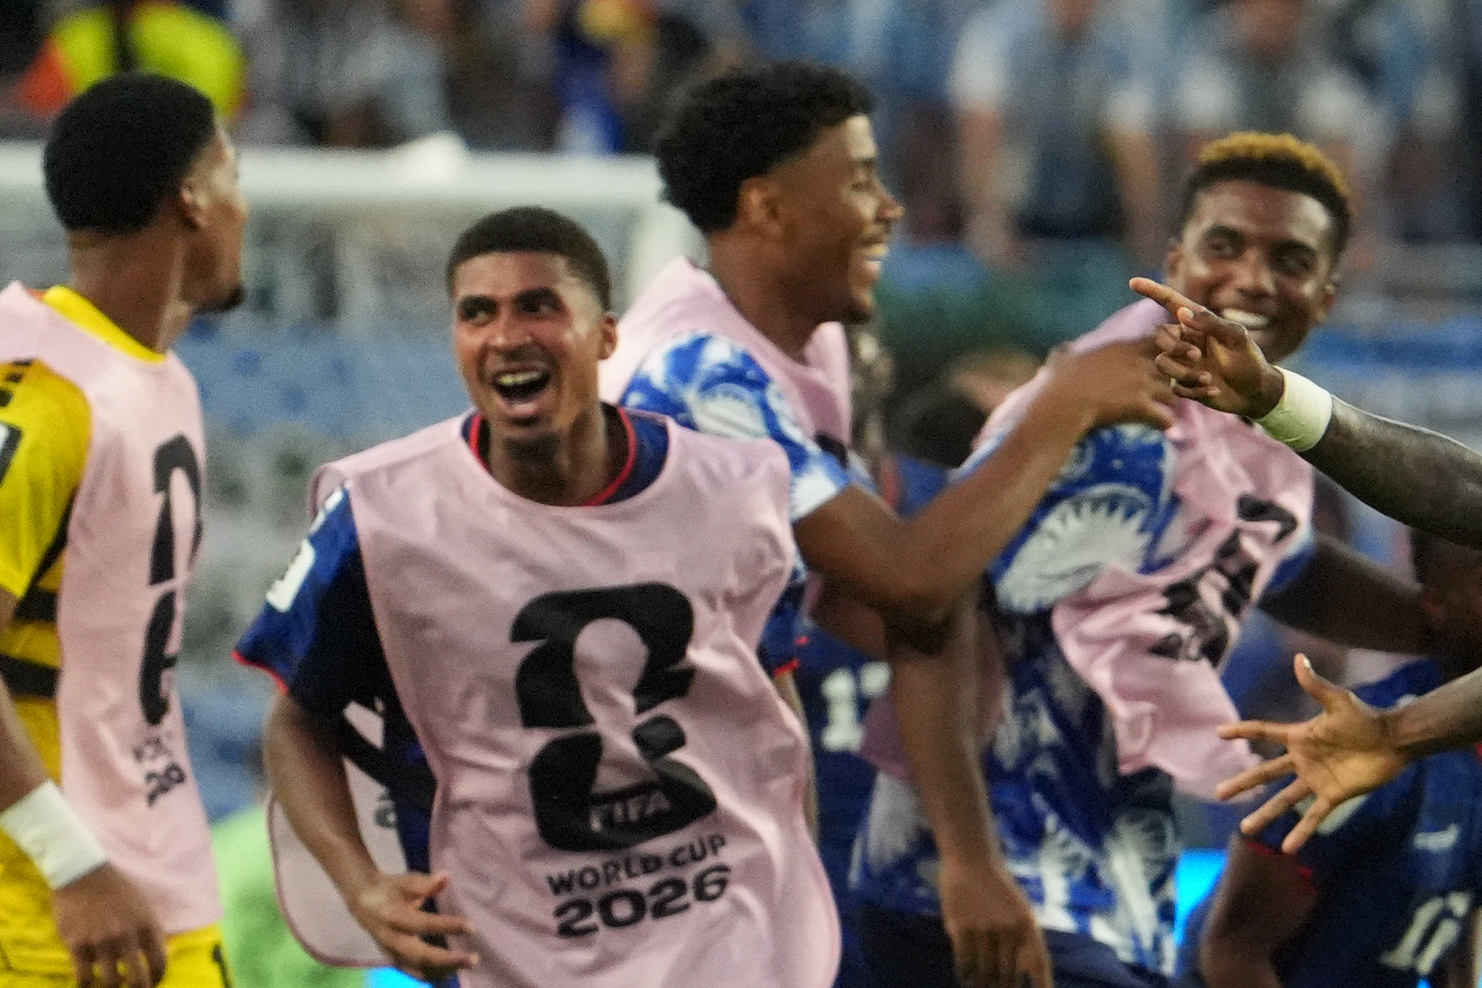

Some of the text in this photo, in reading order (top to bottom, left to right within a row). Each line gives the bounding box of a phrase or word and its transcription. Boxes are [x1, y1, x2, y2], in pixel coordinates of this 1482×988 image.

[589, 790, 673, 833] FIFA
[546, 832, 728, 897] WORLD CUP
[552, 863, 732, 939] 2026
